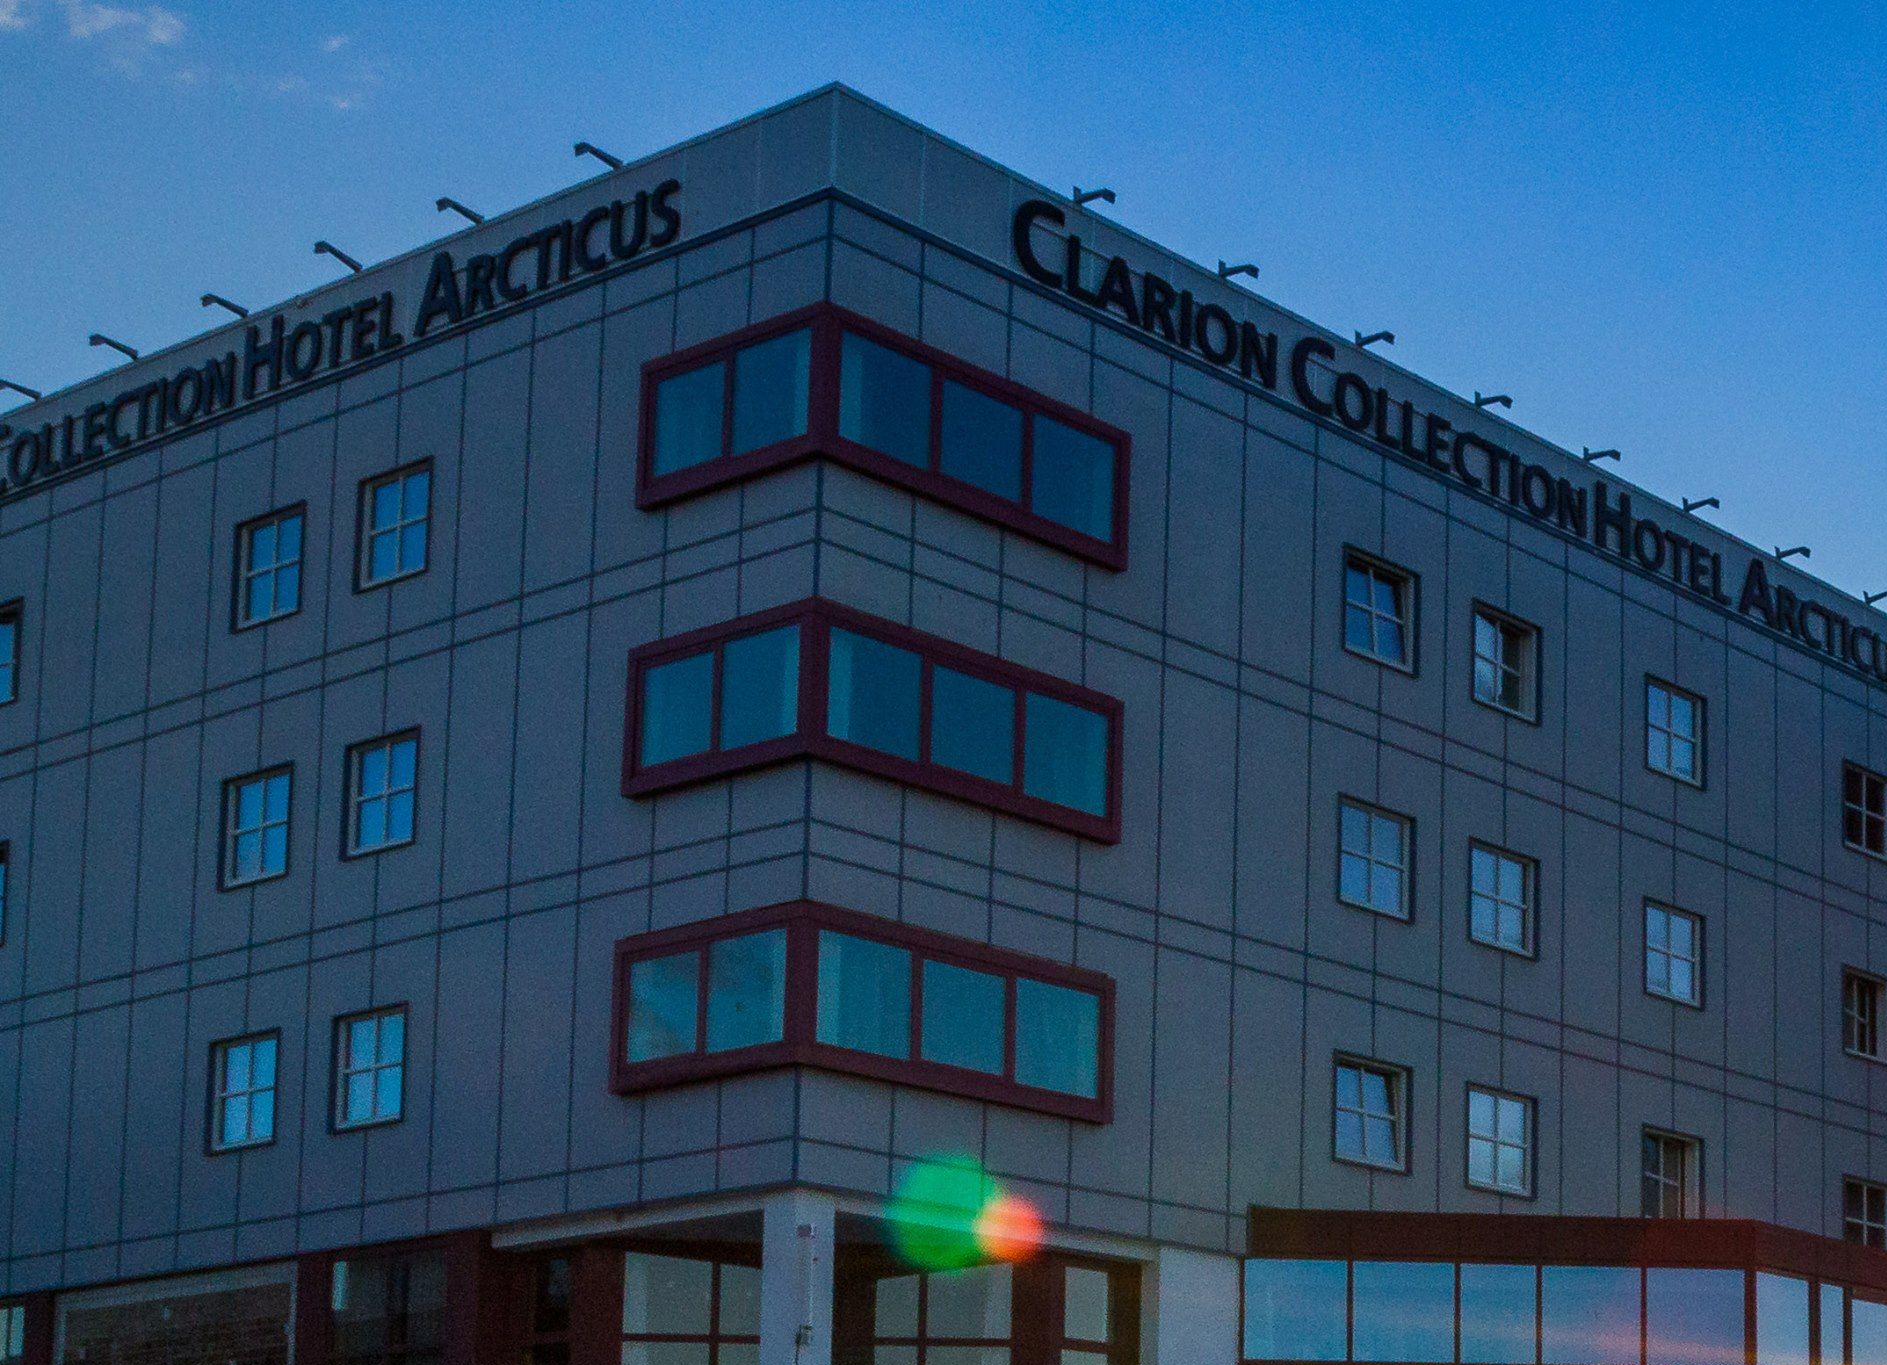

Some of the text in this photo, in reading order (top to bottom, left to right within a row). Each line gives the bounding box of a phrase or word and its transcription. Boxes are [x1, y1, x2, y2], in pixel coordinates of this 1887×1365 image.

[0, 177, 680, 492] OLLECTION HOTEL ARCTICUS
[1013, 199, 1278, 388] CLARION
[1292, 337, 1587, 539] COLLECTION
[1594, 480, 1731, 606] HOTEL
